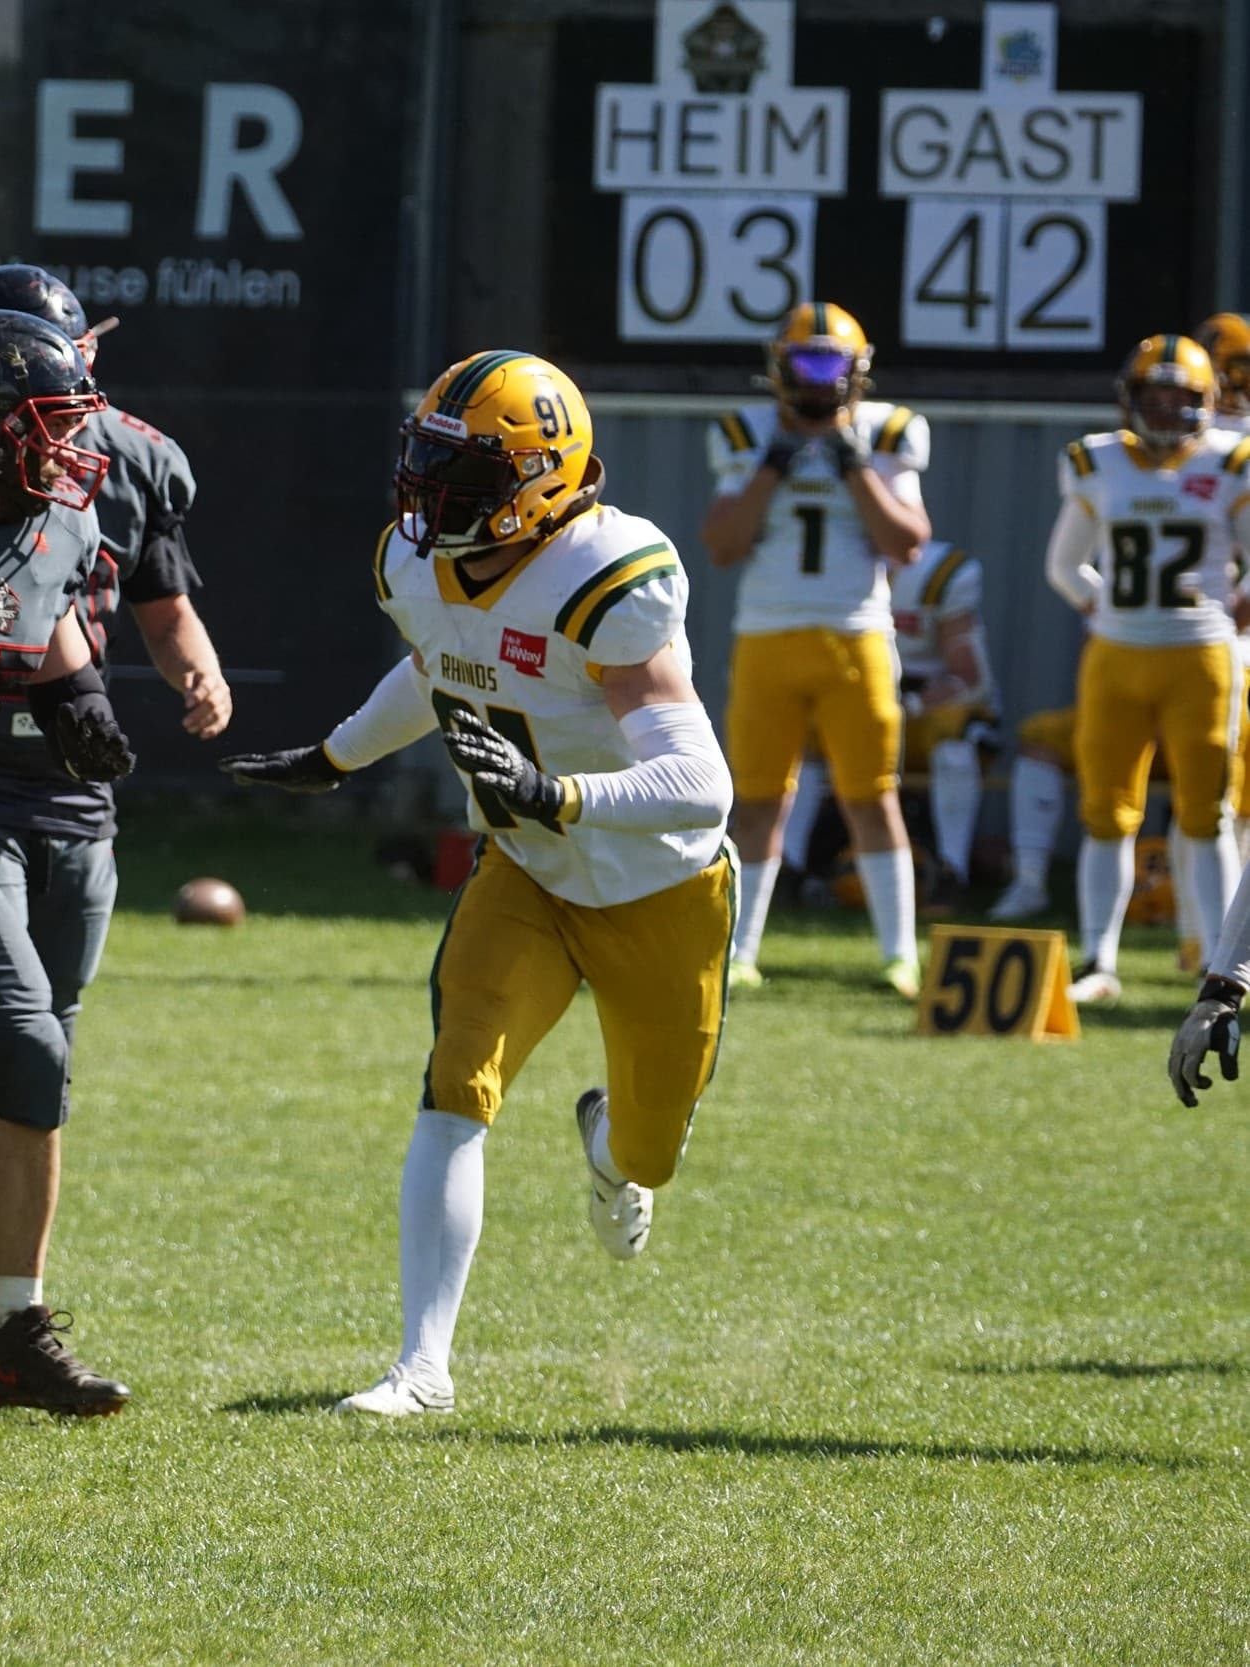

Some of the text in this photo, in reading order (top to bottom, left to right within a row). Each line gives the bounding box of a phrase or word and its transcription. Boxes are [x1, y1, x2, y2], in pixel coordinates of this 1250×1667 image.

[605, 101, 830, 178] HEIM
[890, 104, 1124, 184] GAST
[156, 256, 302, 308] fühlen
[634, 206, 800, 325] 03
[915, 210, 1092, 332] 42
[426, 413, 462, 432] Riddell
[533, 392, 574, 439] 91
[792, 503, 826, 575] 1
[1111, 521, 1208, 609] 82
[441, 652, 498, 692] RHINOS
[933, 937, 1035, 1033] 50
